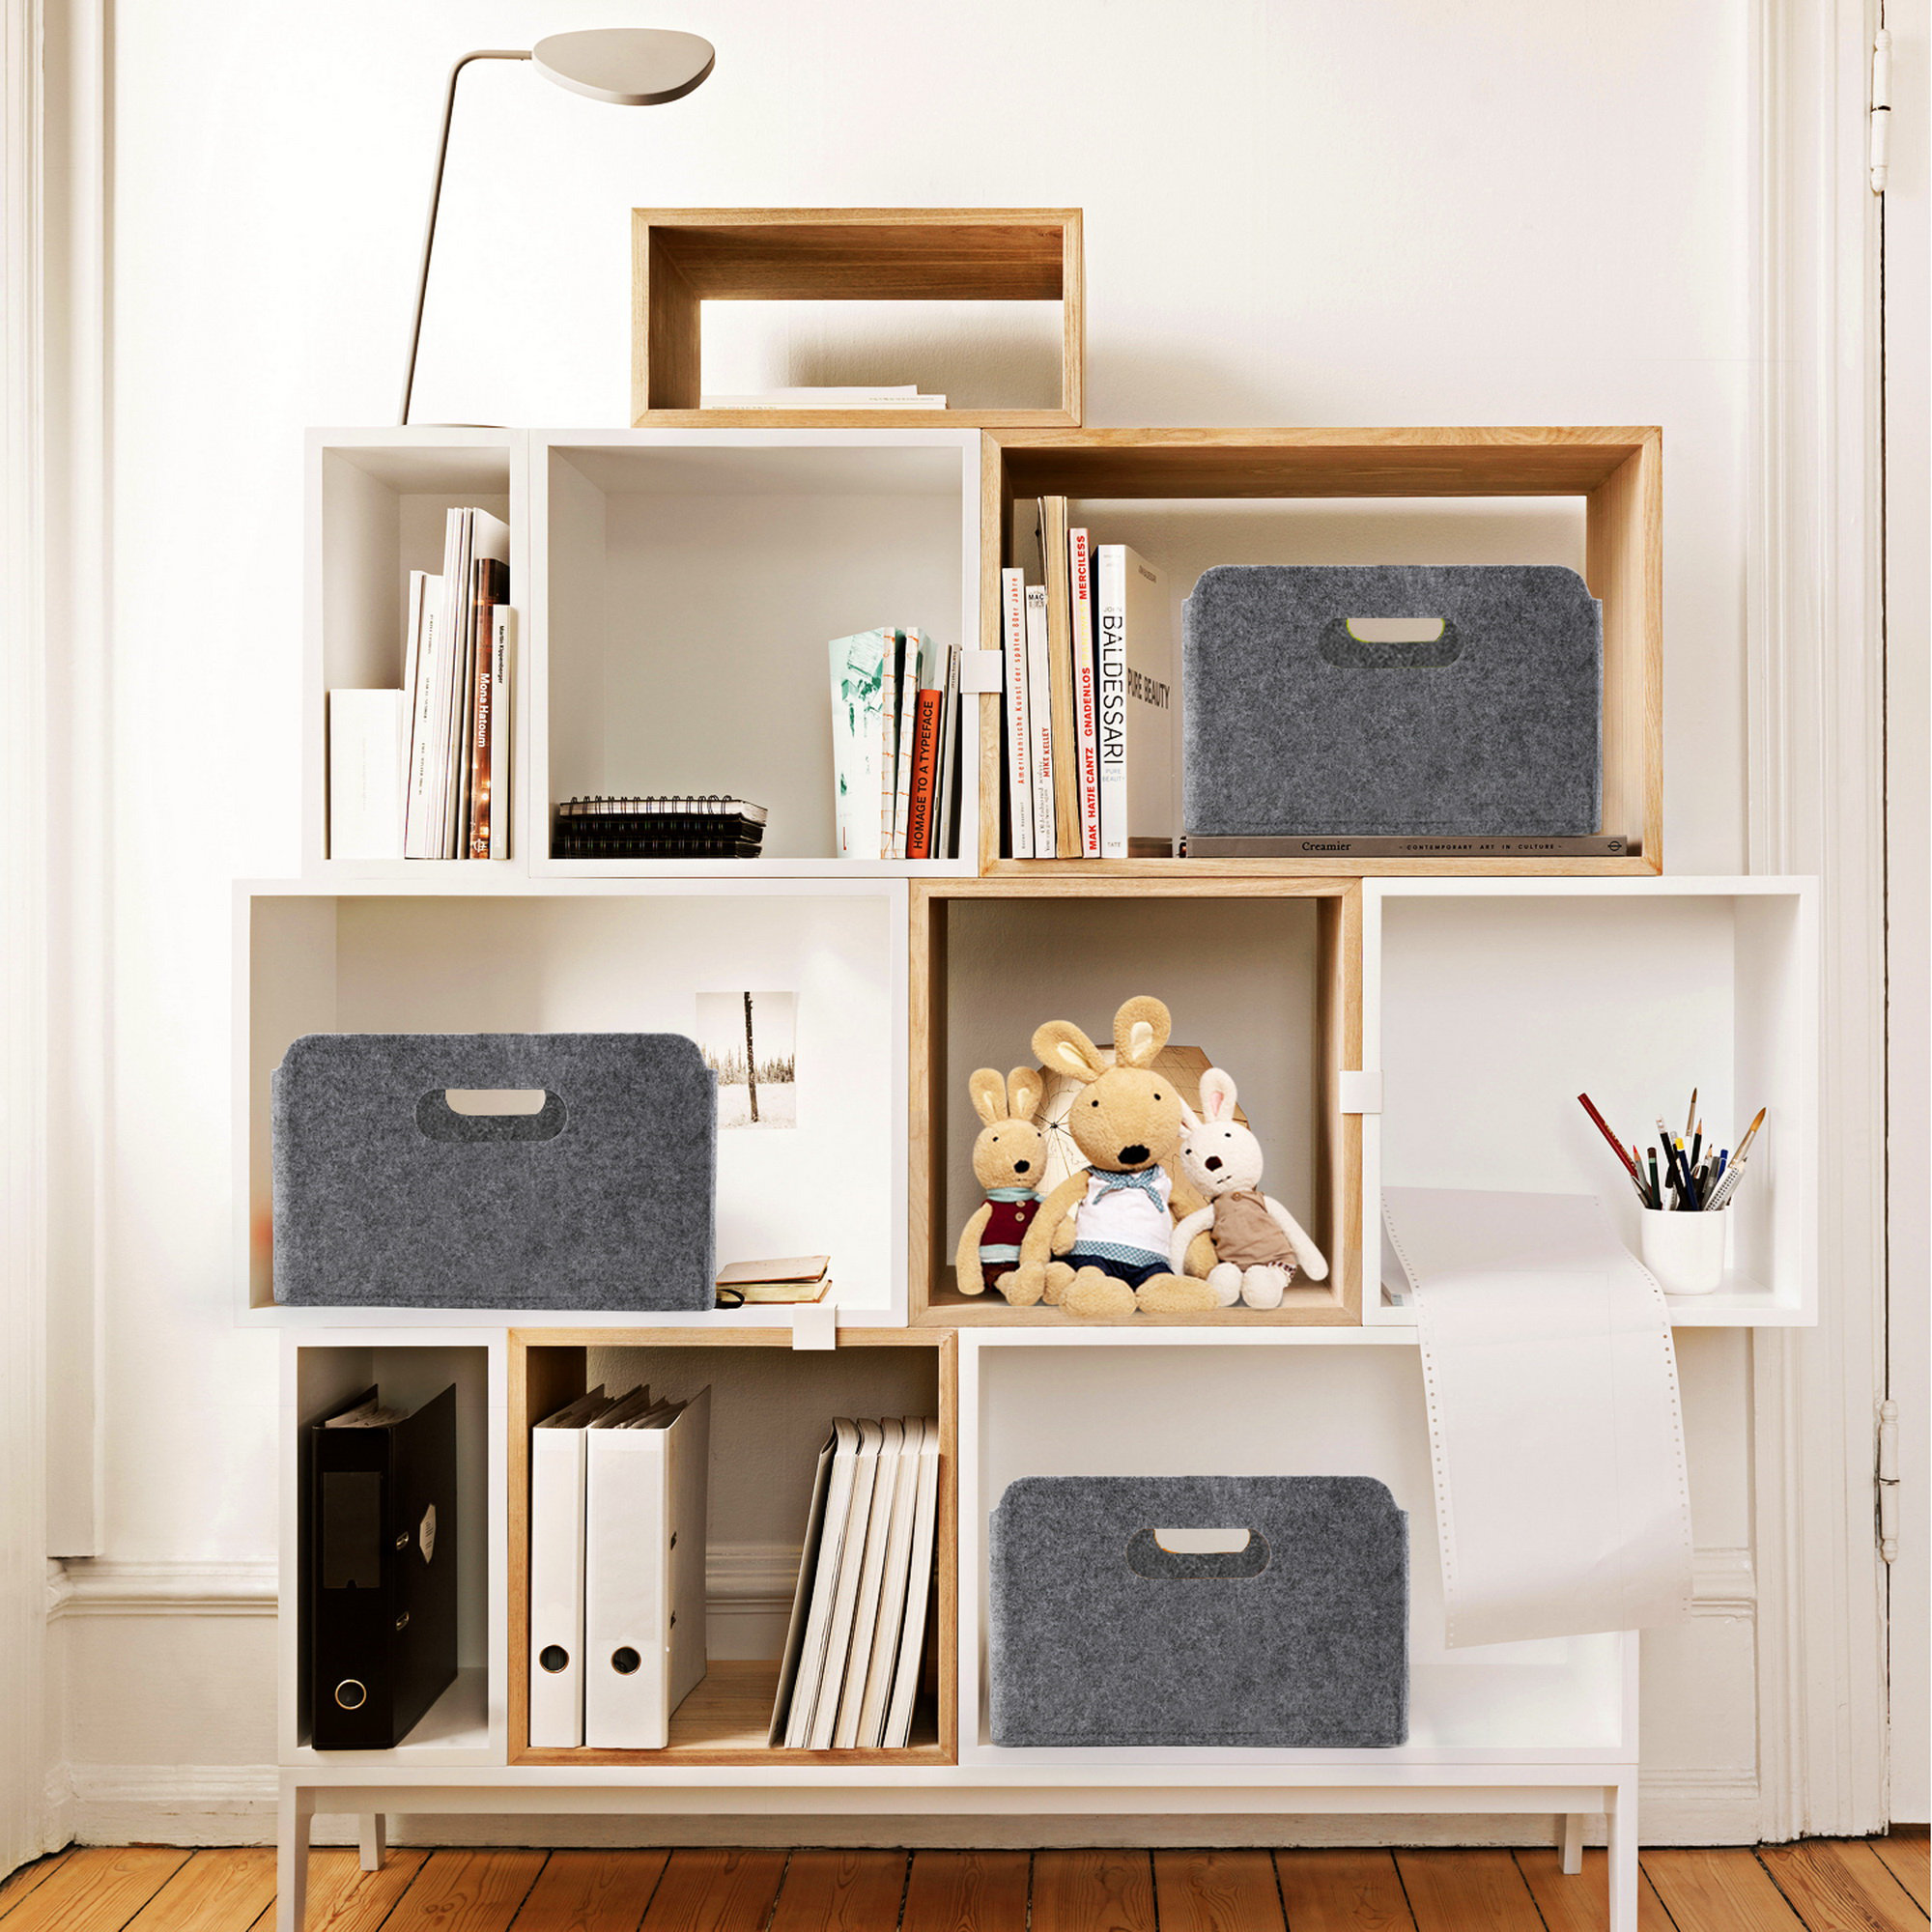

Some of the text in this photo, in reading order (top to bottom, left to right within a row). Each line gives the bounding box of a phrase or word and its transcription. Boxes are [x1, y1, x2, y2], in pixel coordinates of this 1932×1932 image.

[1077, 535, 1088, 600] MERCILESS
[1010, 578, 1019, 603] Jahre
[1011, 608, 1020, 628] 80er
[1013, 667, 1022, 682] der
[1103, 615, 1124, 764] BALDESSARI
[1127, 668, 1171, 710] PURE BEAUTY
[477, 672, 490, 748] Mona Hatoum
[1014, 686, 1023, 712] Kunst
[1082, 667, 1094, 737] GNADENLOS
[1015, 717, 1025, 784] Amerikanische
[1041, 726, 1051, 754] KELLEY
[913, 700, 933, 849] HOMAGE TO A TYPEFACE
[1042, 756, 1051, 778] MIKE
[1085, 747, 1096, 817] HATJE CANTZ
[1089, 825, 1097, 851] MAK
[1301, 840, 1352, 852] Creamier
